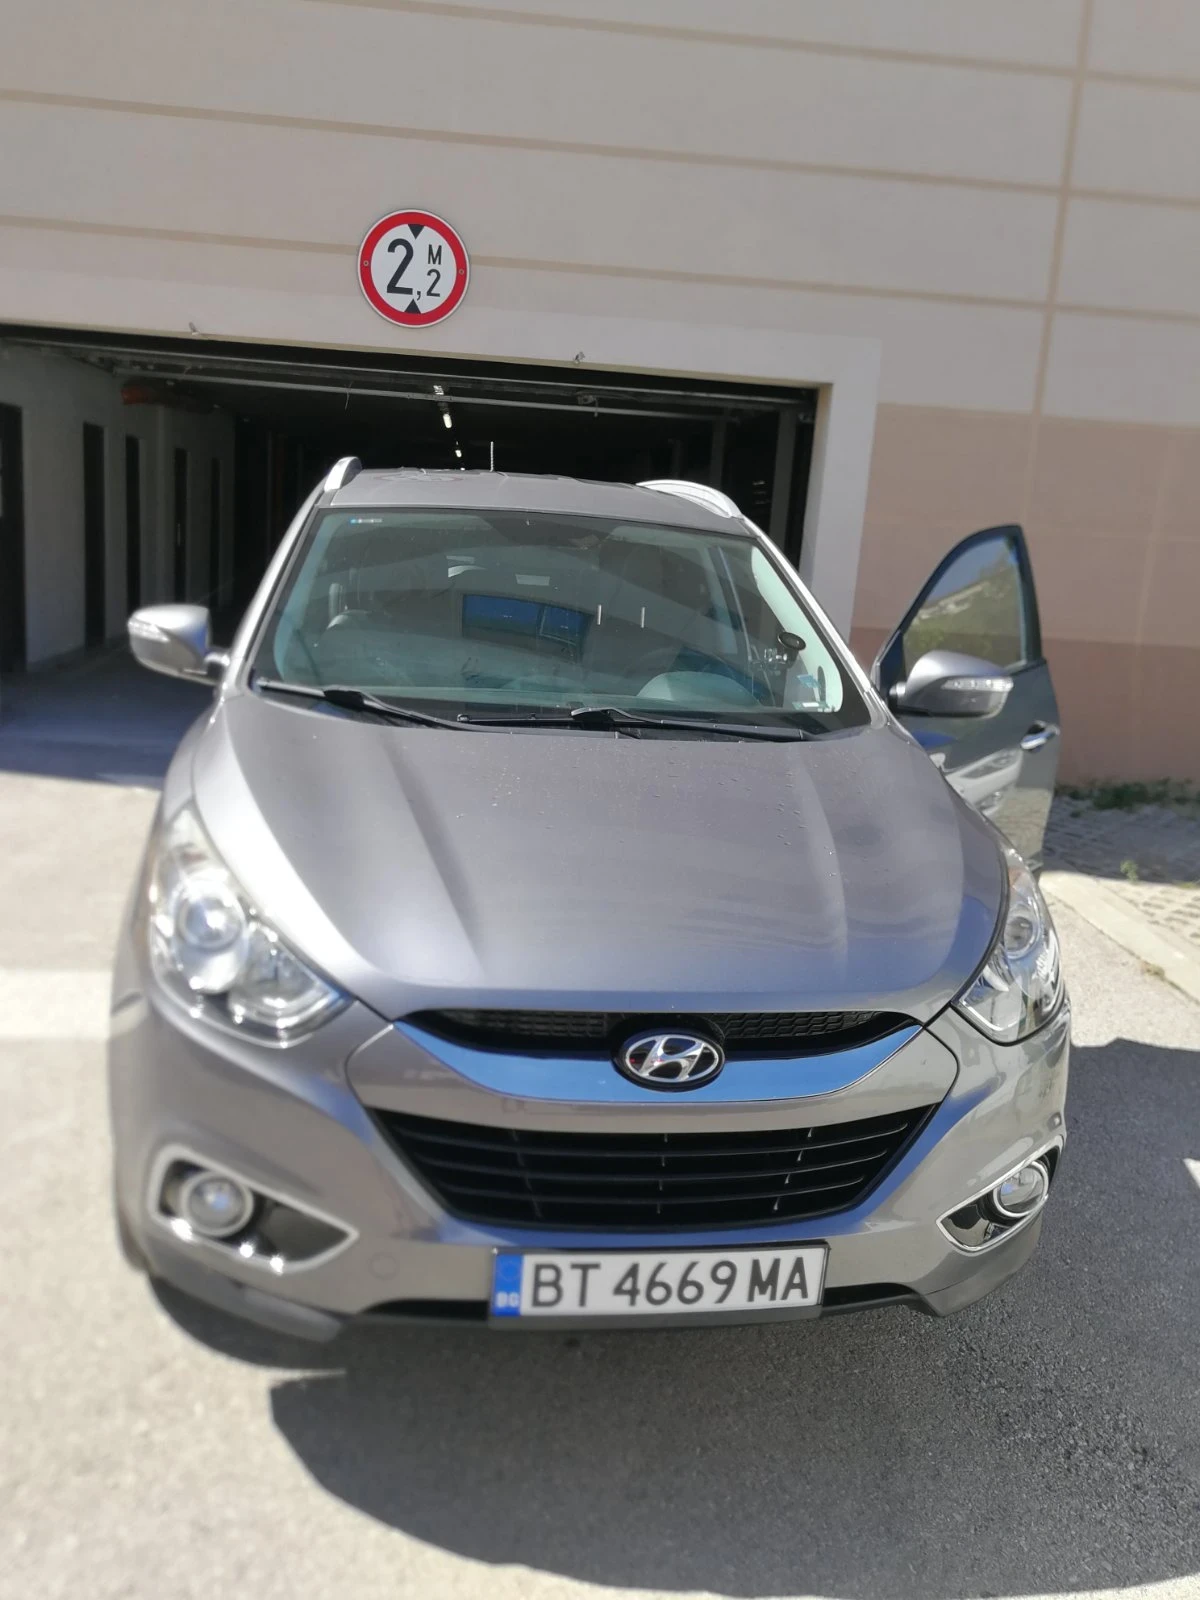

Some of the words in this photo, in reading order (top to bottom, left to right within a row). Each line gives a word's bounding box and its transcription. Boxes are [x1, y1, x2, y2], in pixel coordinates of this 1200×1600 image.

[427, 244, 442, 265] M
[531, 1262, 601, 1308] BT
[612, 1259, 738, 1307] 4669
[747, 1256, 809, 1303] MA
